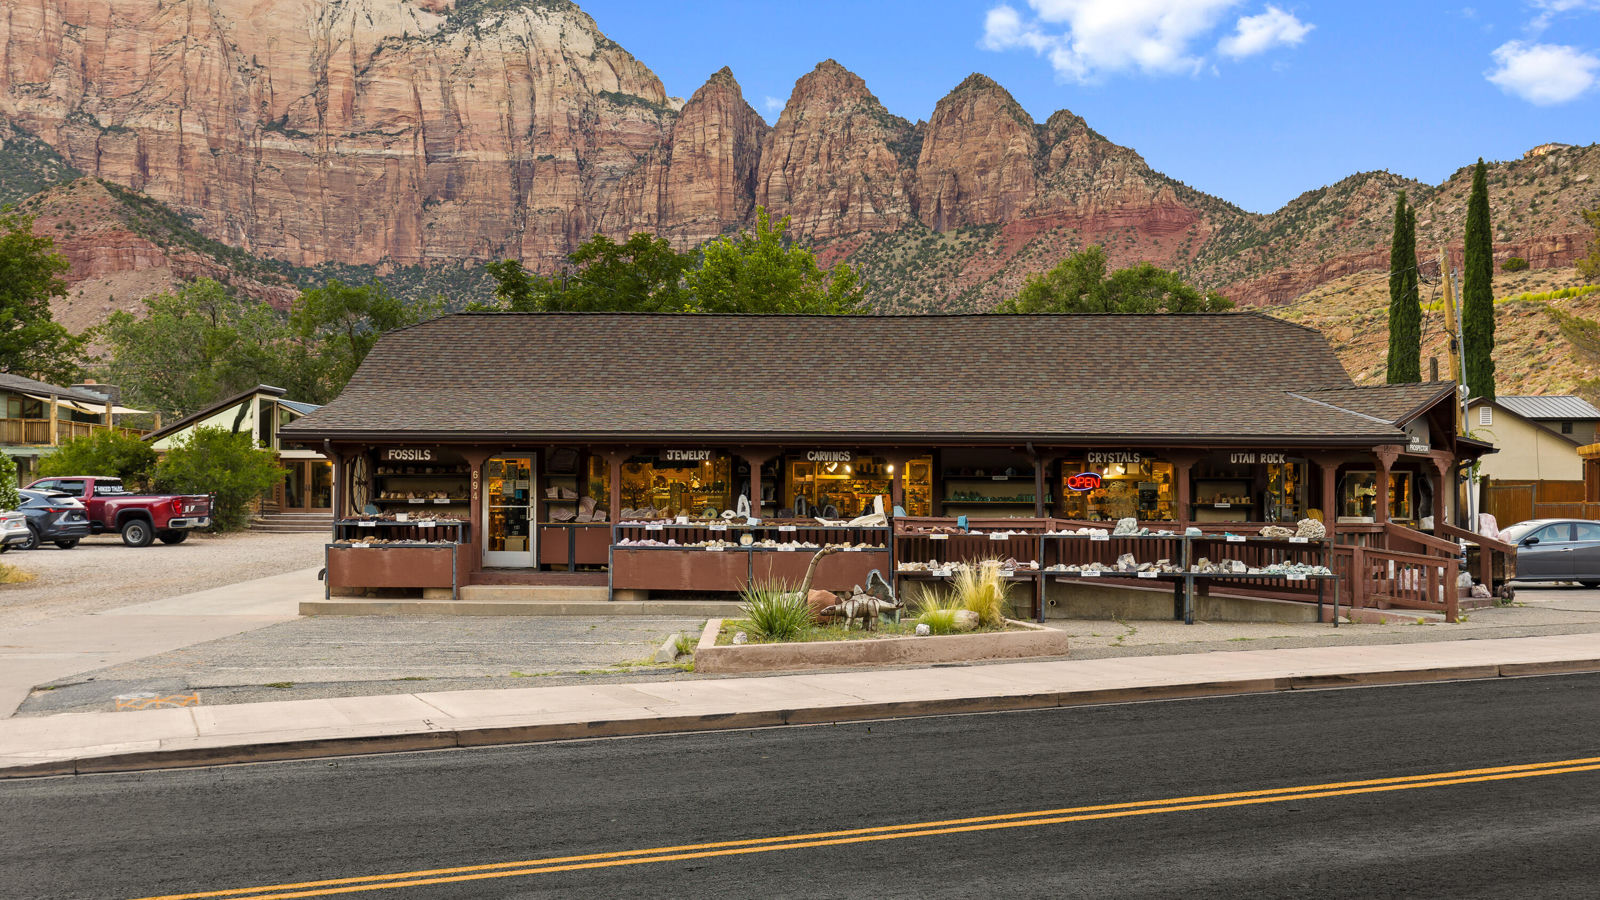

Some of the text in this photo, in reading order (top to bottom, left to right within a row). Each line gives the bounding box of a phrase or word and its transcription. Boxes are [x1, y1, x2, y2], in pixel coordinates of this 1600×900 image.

[388, 449, 431, 460] FOSSILS
[666, 450, 711, 460] JEWELRY
[807, 451, 851, 461] CARVINGS
[1087, 452, 1140, 463] CRYSTALS
[1230, 453, 1286, 464] UTAH ROCK
[1068, 476, 1100, 488] OPEN
